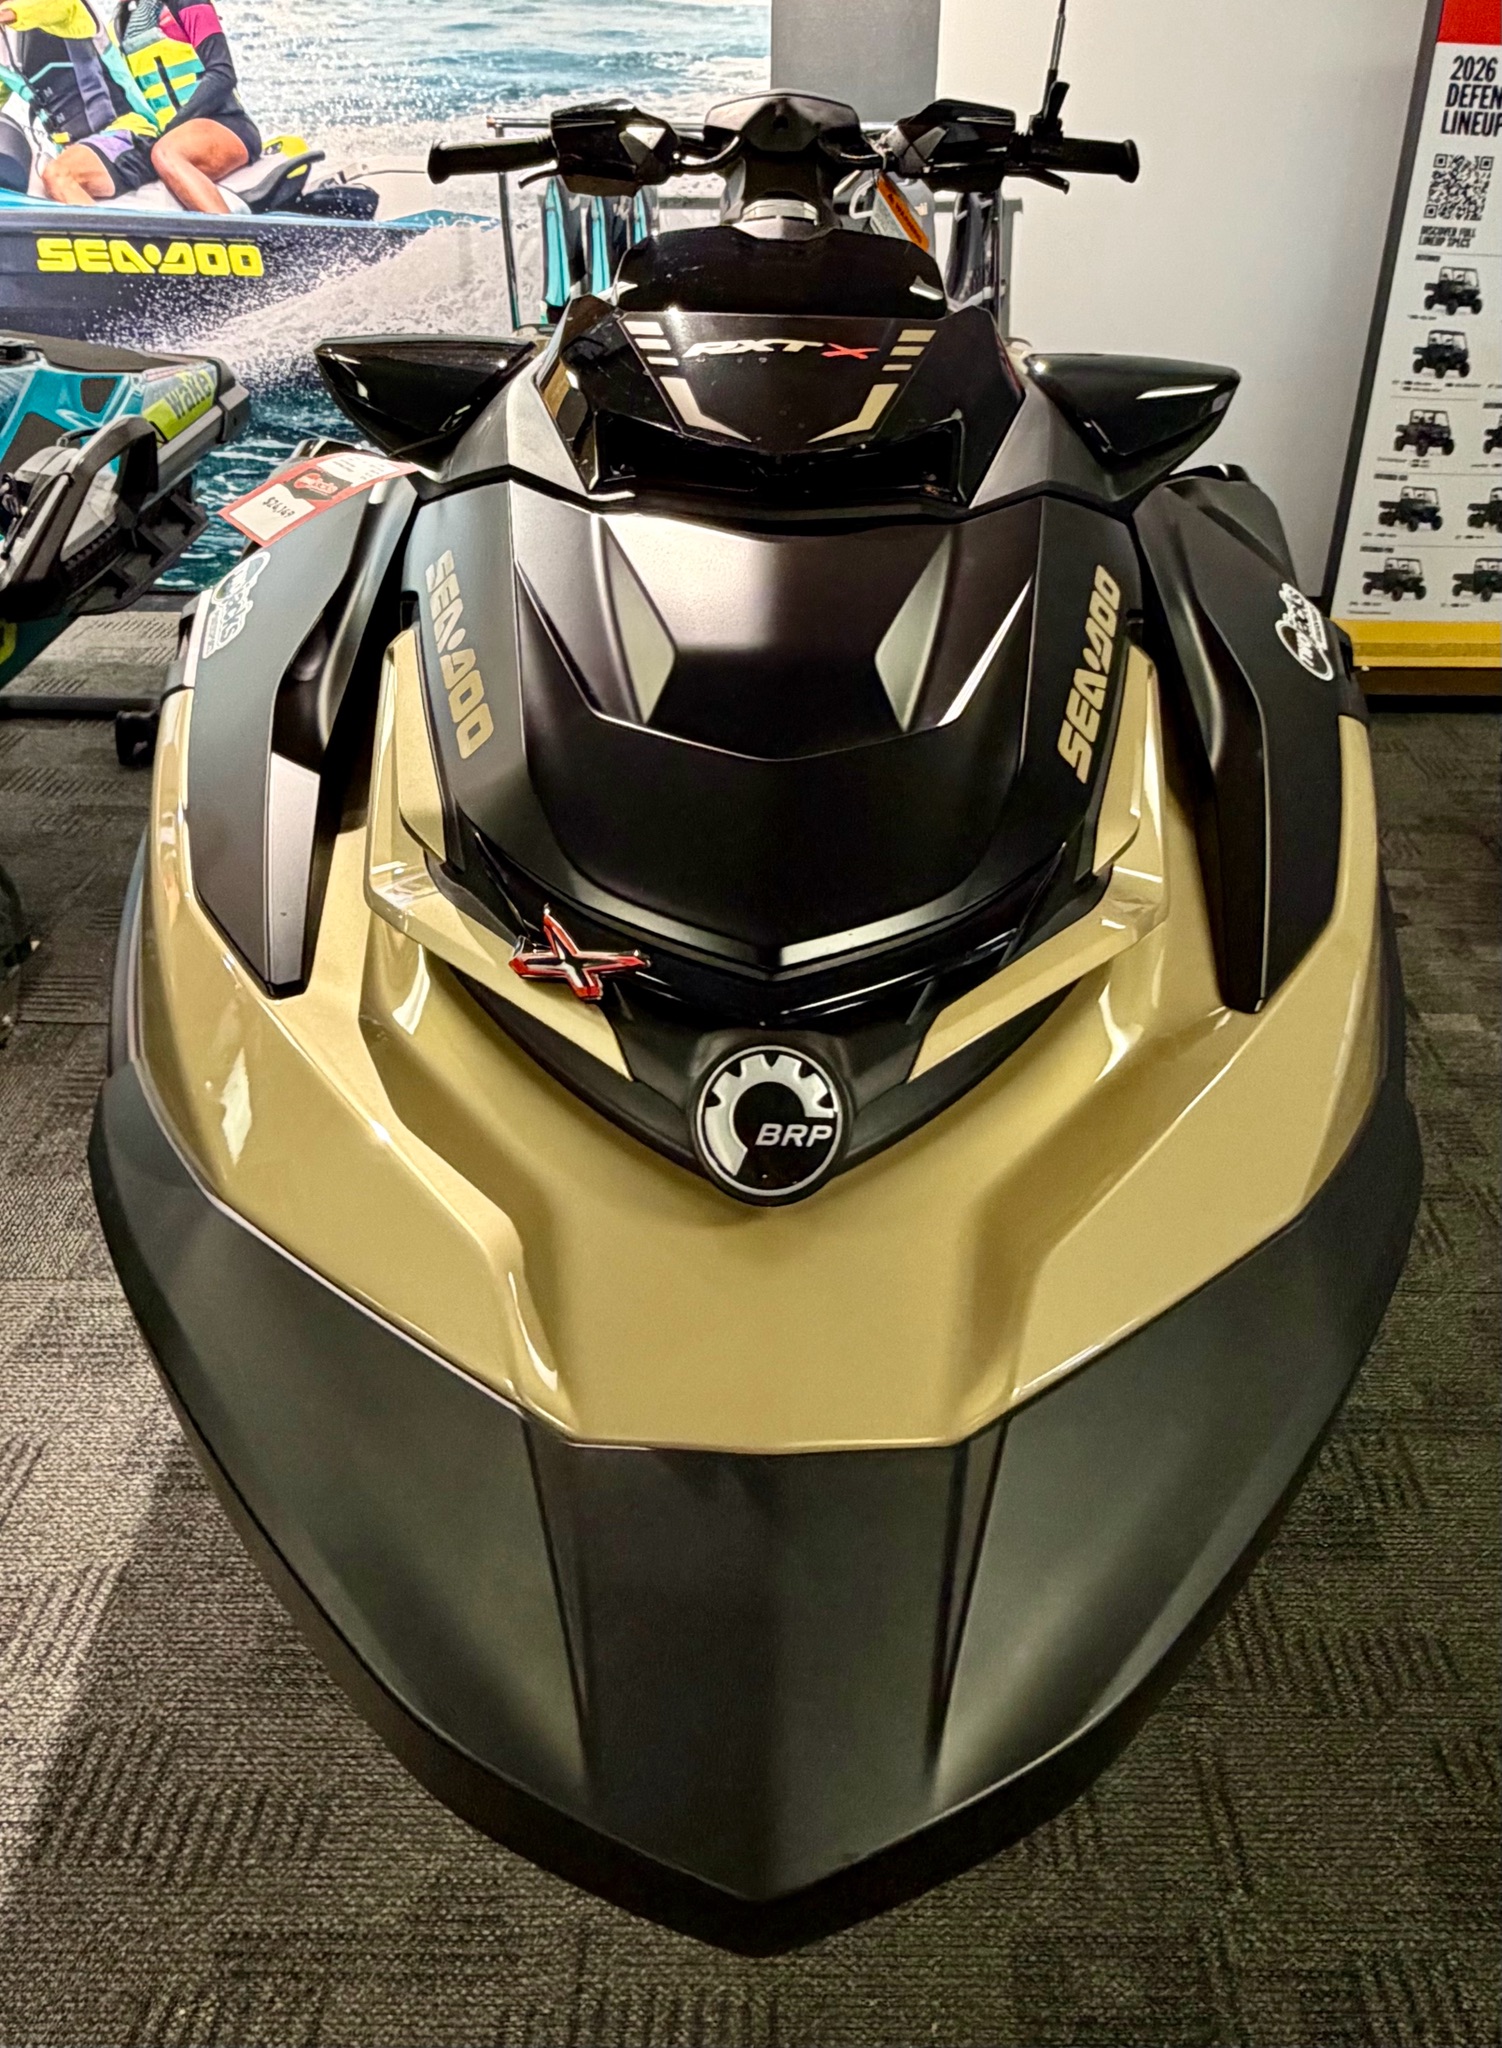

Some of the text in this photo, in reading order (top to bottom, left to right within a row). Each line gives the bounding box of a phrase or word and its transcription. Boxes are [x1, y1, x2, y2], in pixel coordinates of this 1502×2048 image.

[1450, 55, 1498, 82] 2026
[1441, 109, 1502, 137] LINEUP
[755, 1123, 833, 1147] BRP
